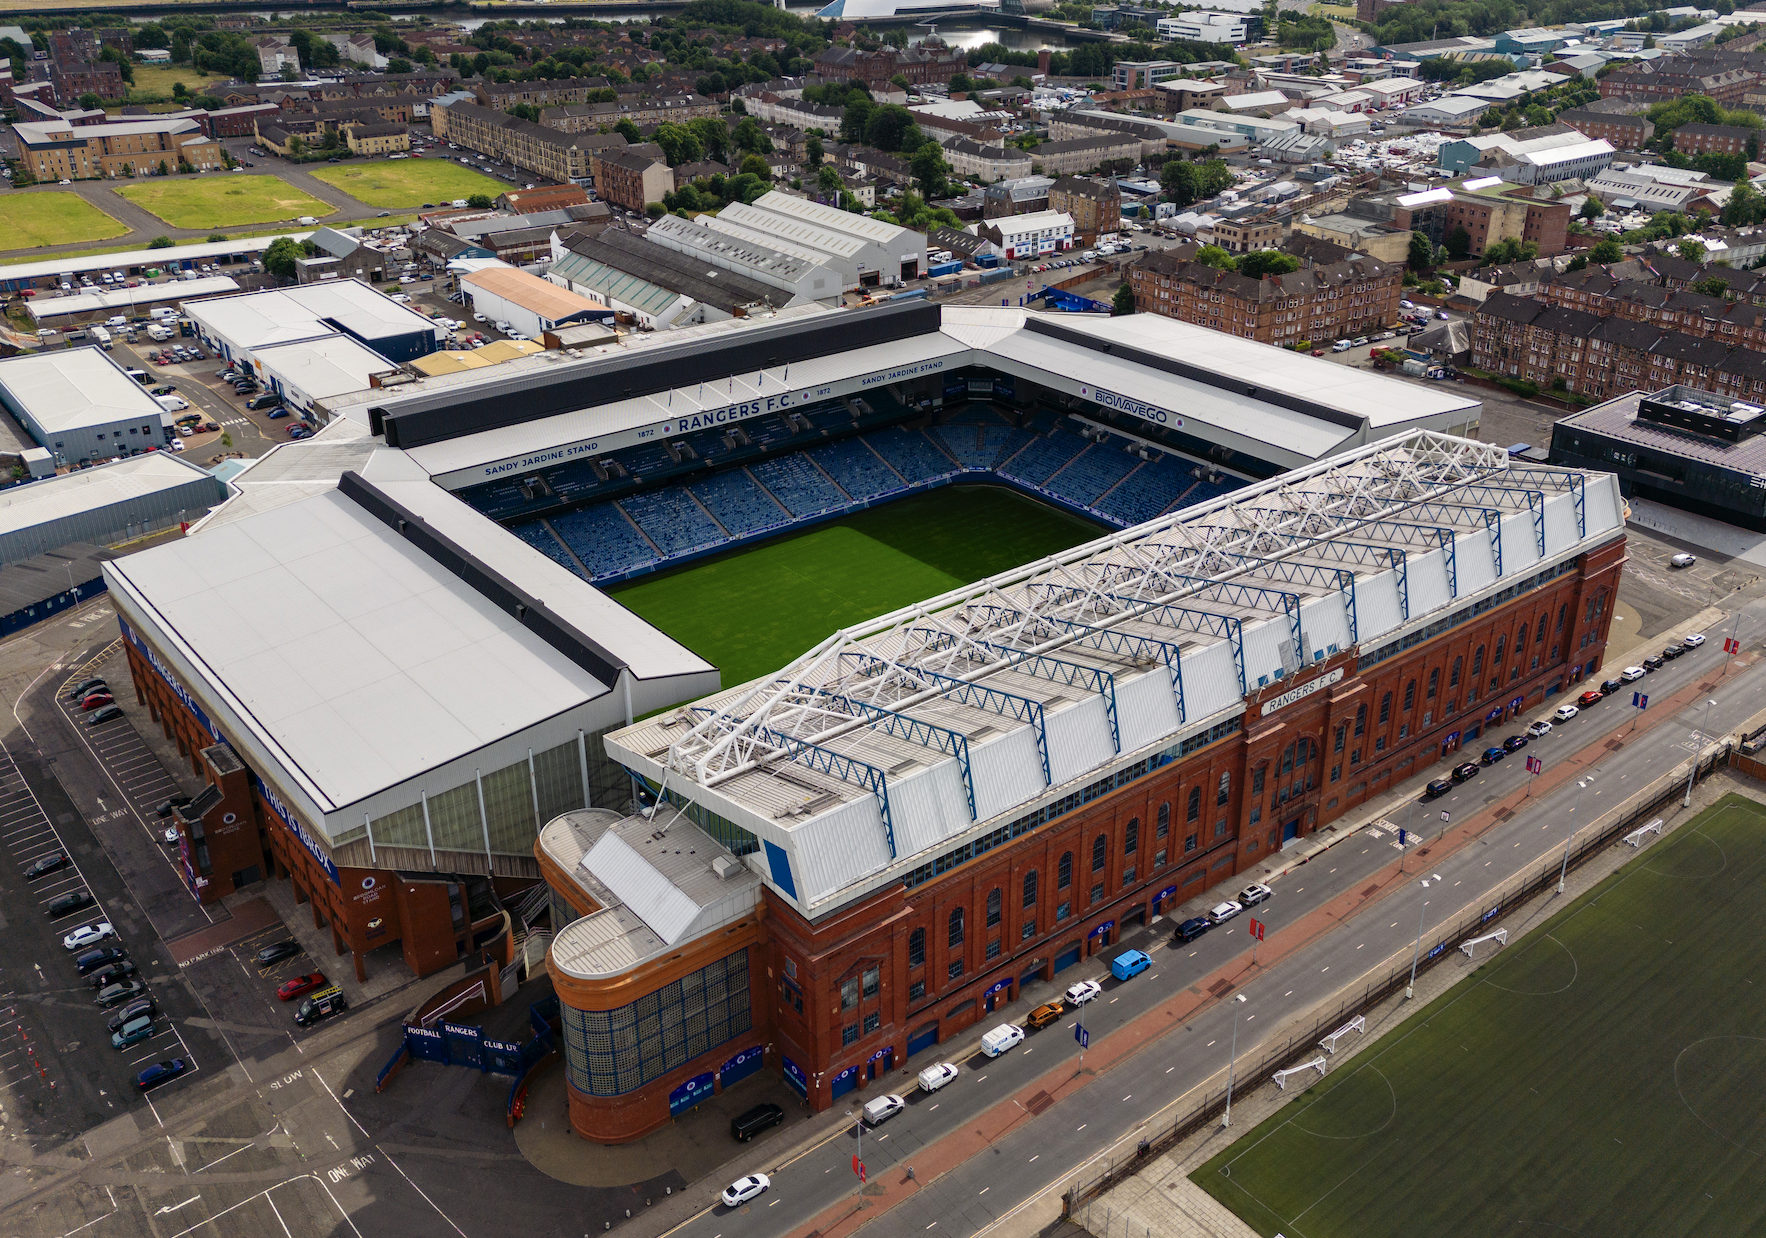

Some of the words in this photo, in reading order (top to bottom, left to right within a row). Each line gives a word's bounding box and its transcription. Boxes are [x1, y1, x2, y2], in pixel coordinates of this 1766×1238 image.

[862, 374, 886, 386] SANDY
[888, 366, 918, 381] JARDINE
[920, 361, 943, 372] STAND
[816, 387, 831, 396] 1872
[679, 402, 760, 432] RANGERS
[767, 395, 795, 411] F.C.
[638, 429, 655, 439] 1872
[485, 461, 519, 476] SANDY
[522, 451, 564, 467] JARDINE
[567, 442, 598, 456] STAND
[1269, 681, 1315, 712] RANGERS
[92, 813, 110, 826] ONE
[110, 807, 129, 819] WAY
[261, 781, 286, 819] THIS
[286, 810, 298, 832] IS
[297, 822, 332, 874] IBROX
[178, 959, 190, 968] NO
[190, 945, 225, 964] PARKING
[407, 1026, 442, 1039] FOOTBALL
[444, 1024, 478, 1037] RANGERS
[483, 1040, 504, 1050] CLUB
[270, 1069, 303, 1091] SLOW
[327, 1163, 353, 1184] ONE
[350, 1154, 376, 1171] WAY
